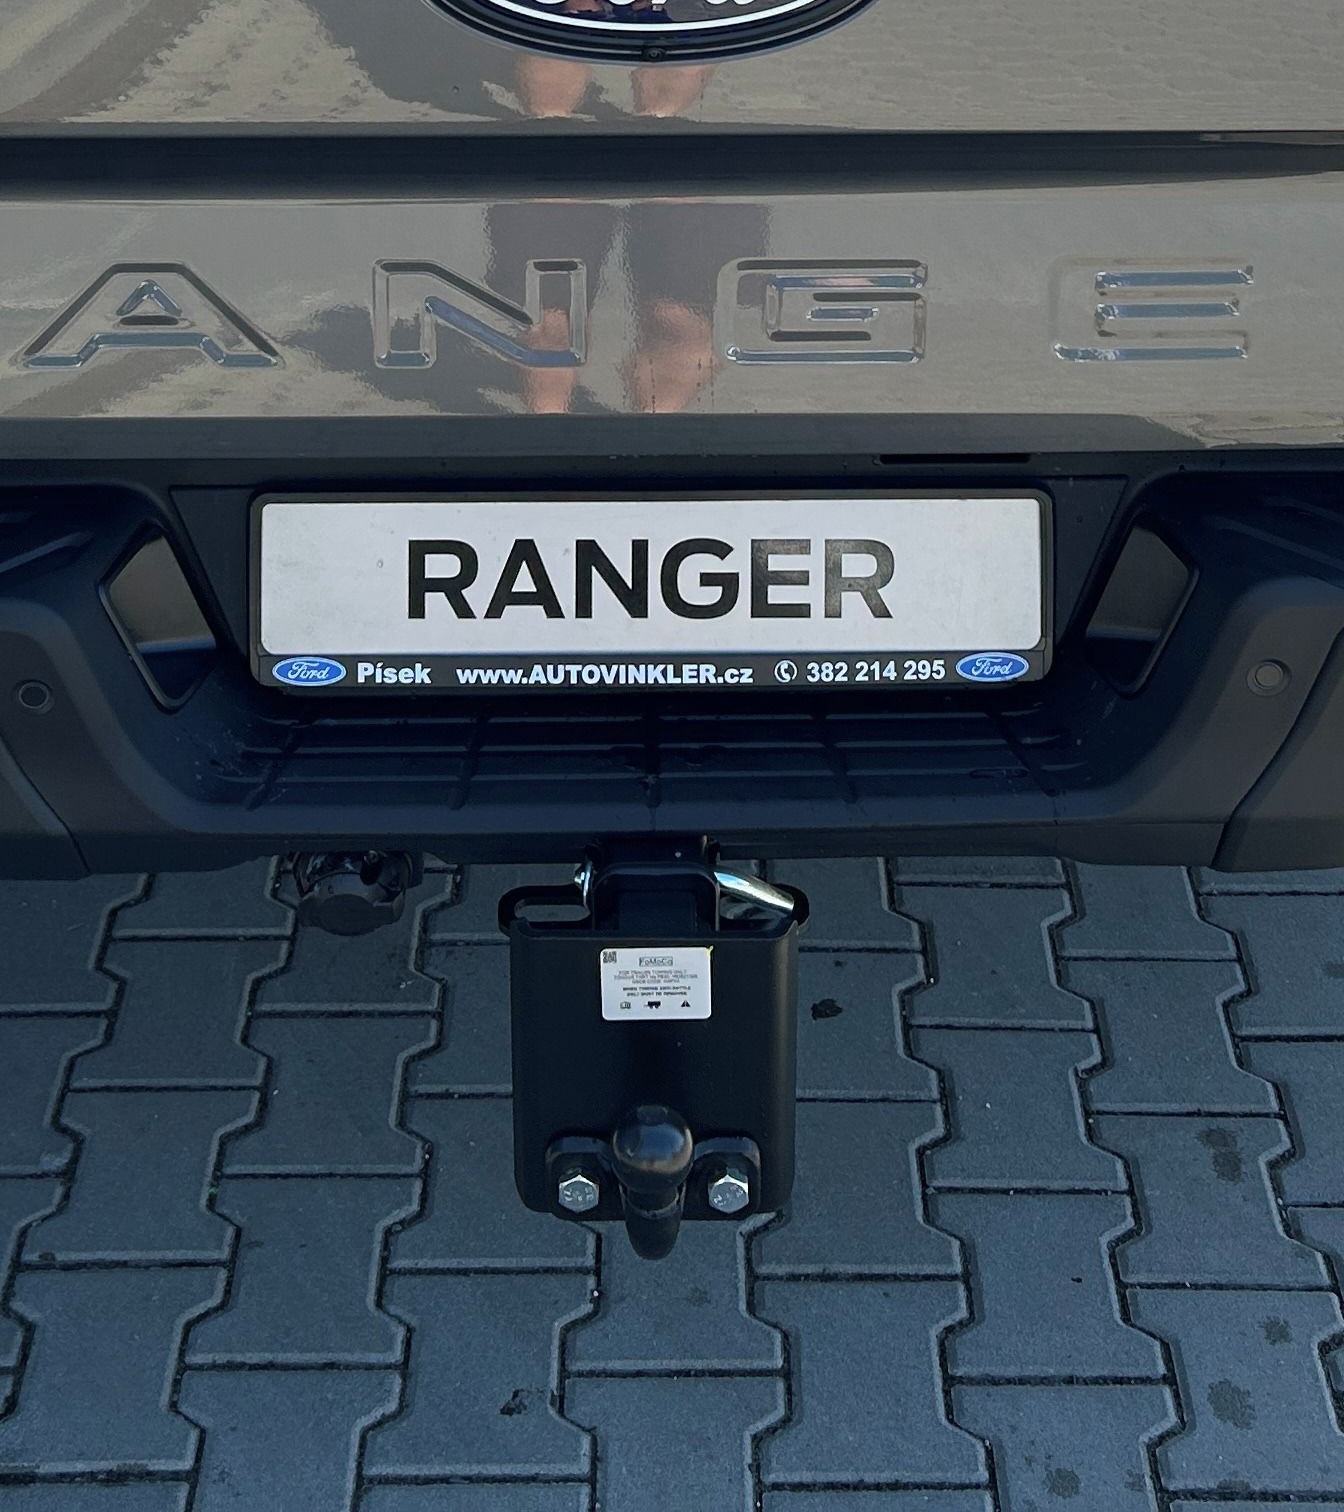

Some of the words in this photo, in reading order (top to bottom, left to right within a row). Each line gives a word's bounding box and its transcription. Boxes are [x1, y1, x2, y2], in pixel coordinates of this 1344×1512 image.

[408, 538, 895, 620] RANGER
[287, 661, 330, 681] Ford
[357, 662, 433, 684] Písek
[456, 664, 754, 685] www.AUTOVINKLER.cz
[806, 661, 848, 683] 382
[855, 660, 898, 682] 214
[903, 659, 946, 680] 295
[970, 656, 1013, 677] Ford
